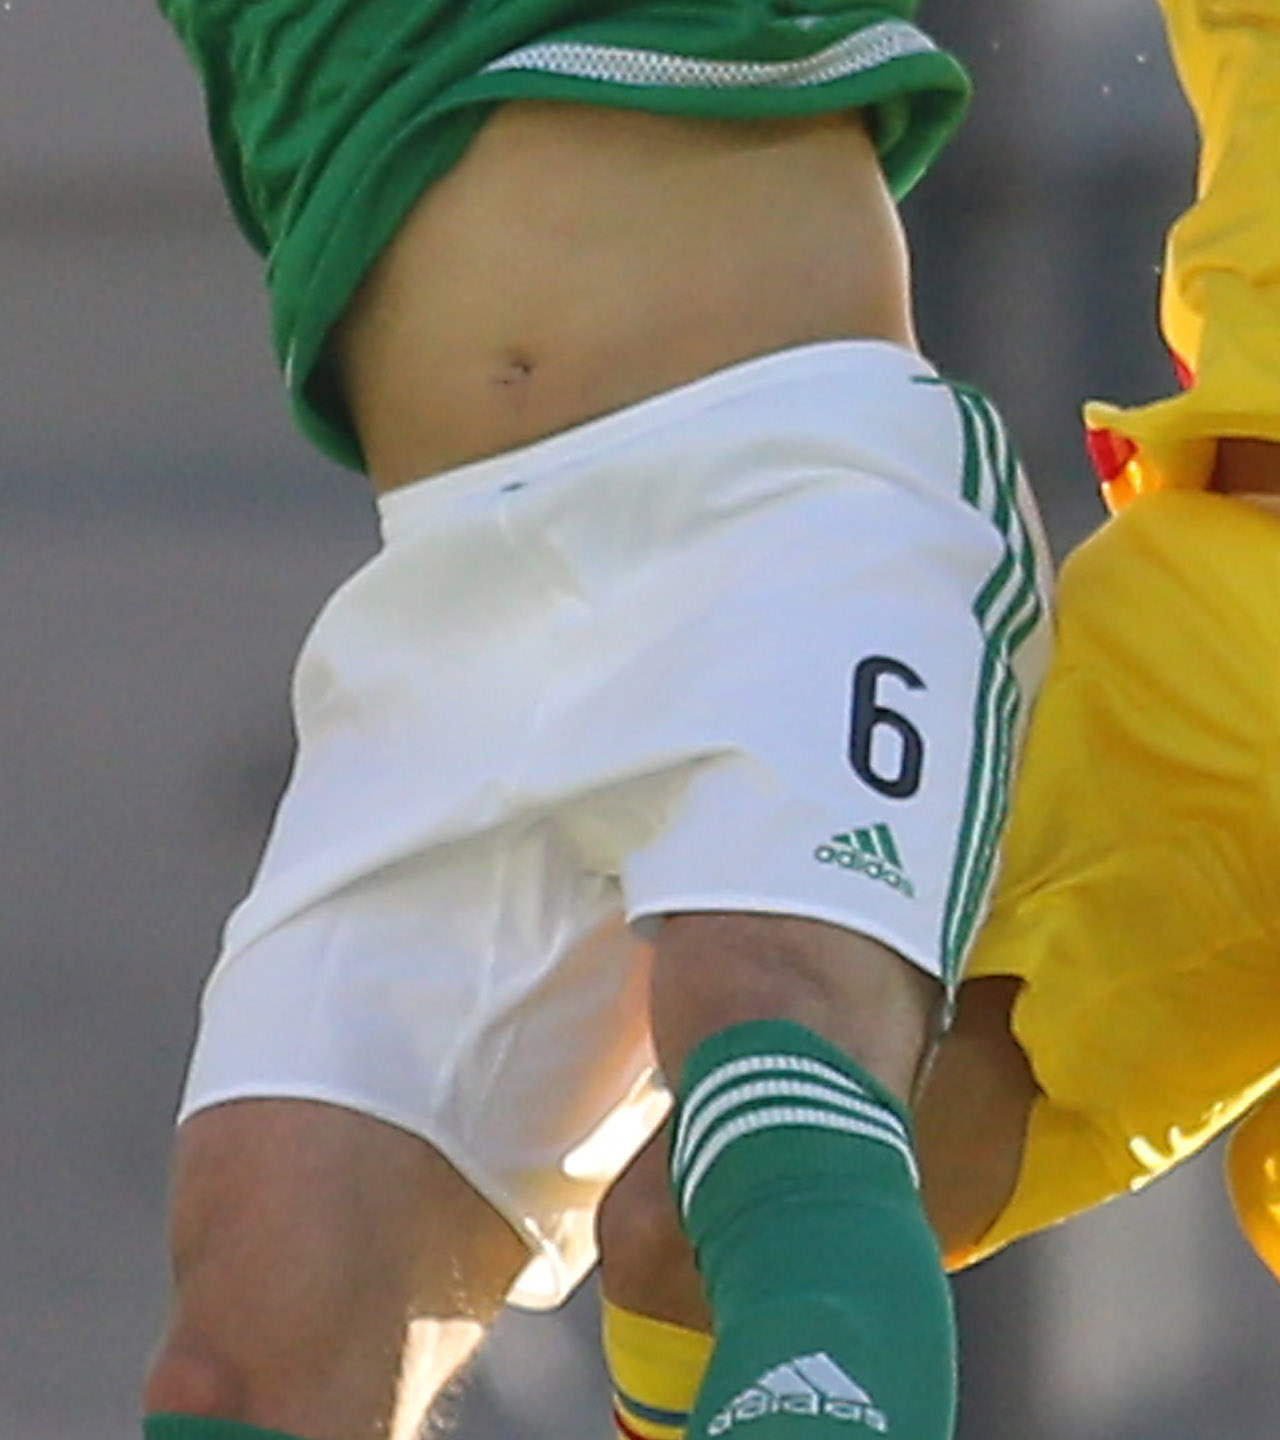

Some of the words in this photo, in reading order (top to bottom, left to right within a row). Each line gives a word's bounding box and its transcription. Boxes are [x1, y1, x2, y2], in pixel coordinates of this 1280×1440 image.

[849, 654, 928, 800] 6
[815, 844, 916, 900] adidas
[707, 1388, 888, 1436] adidas
